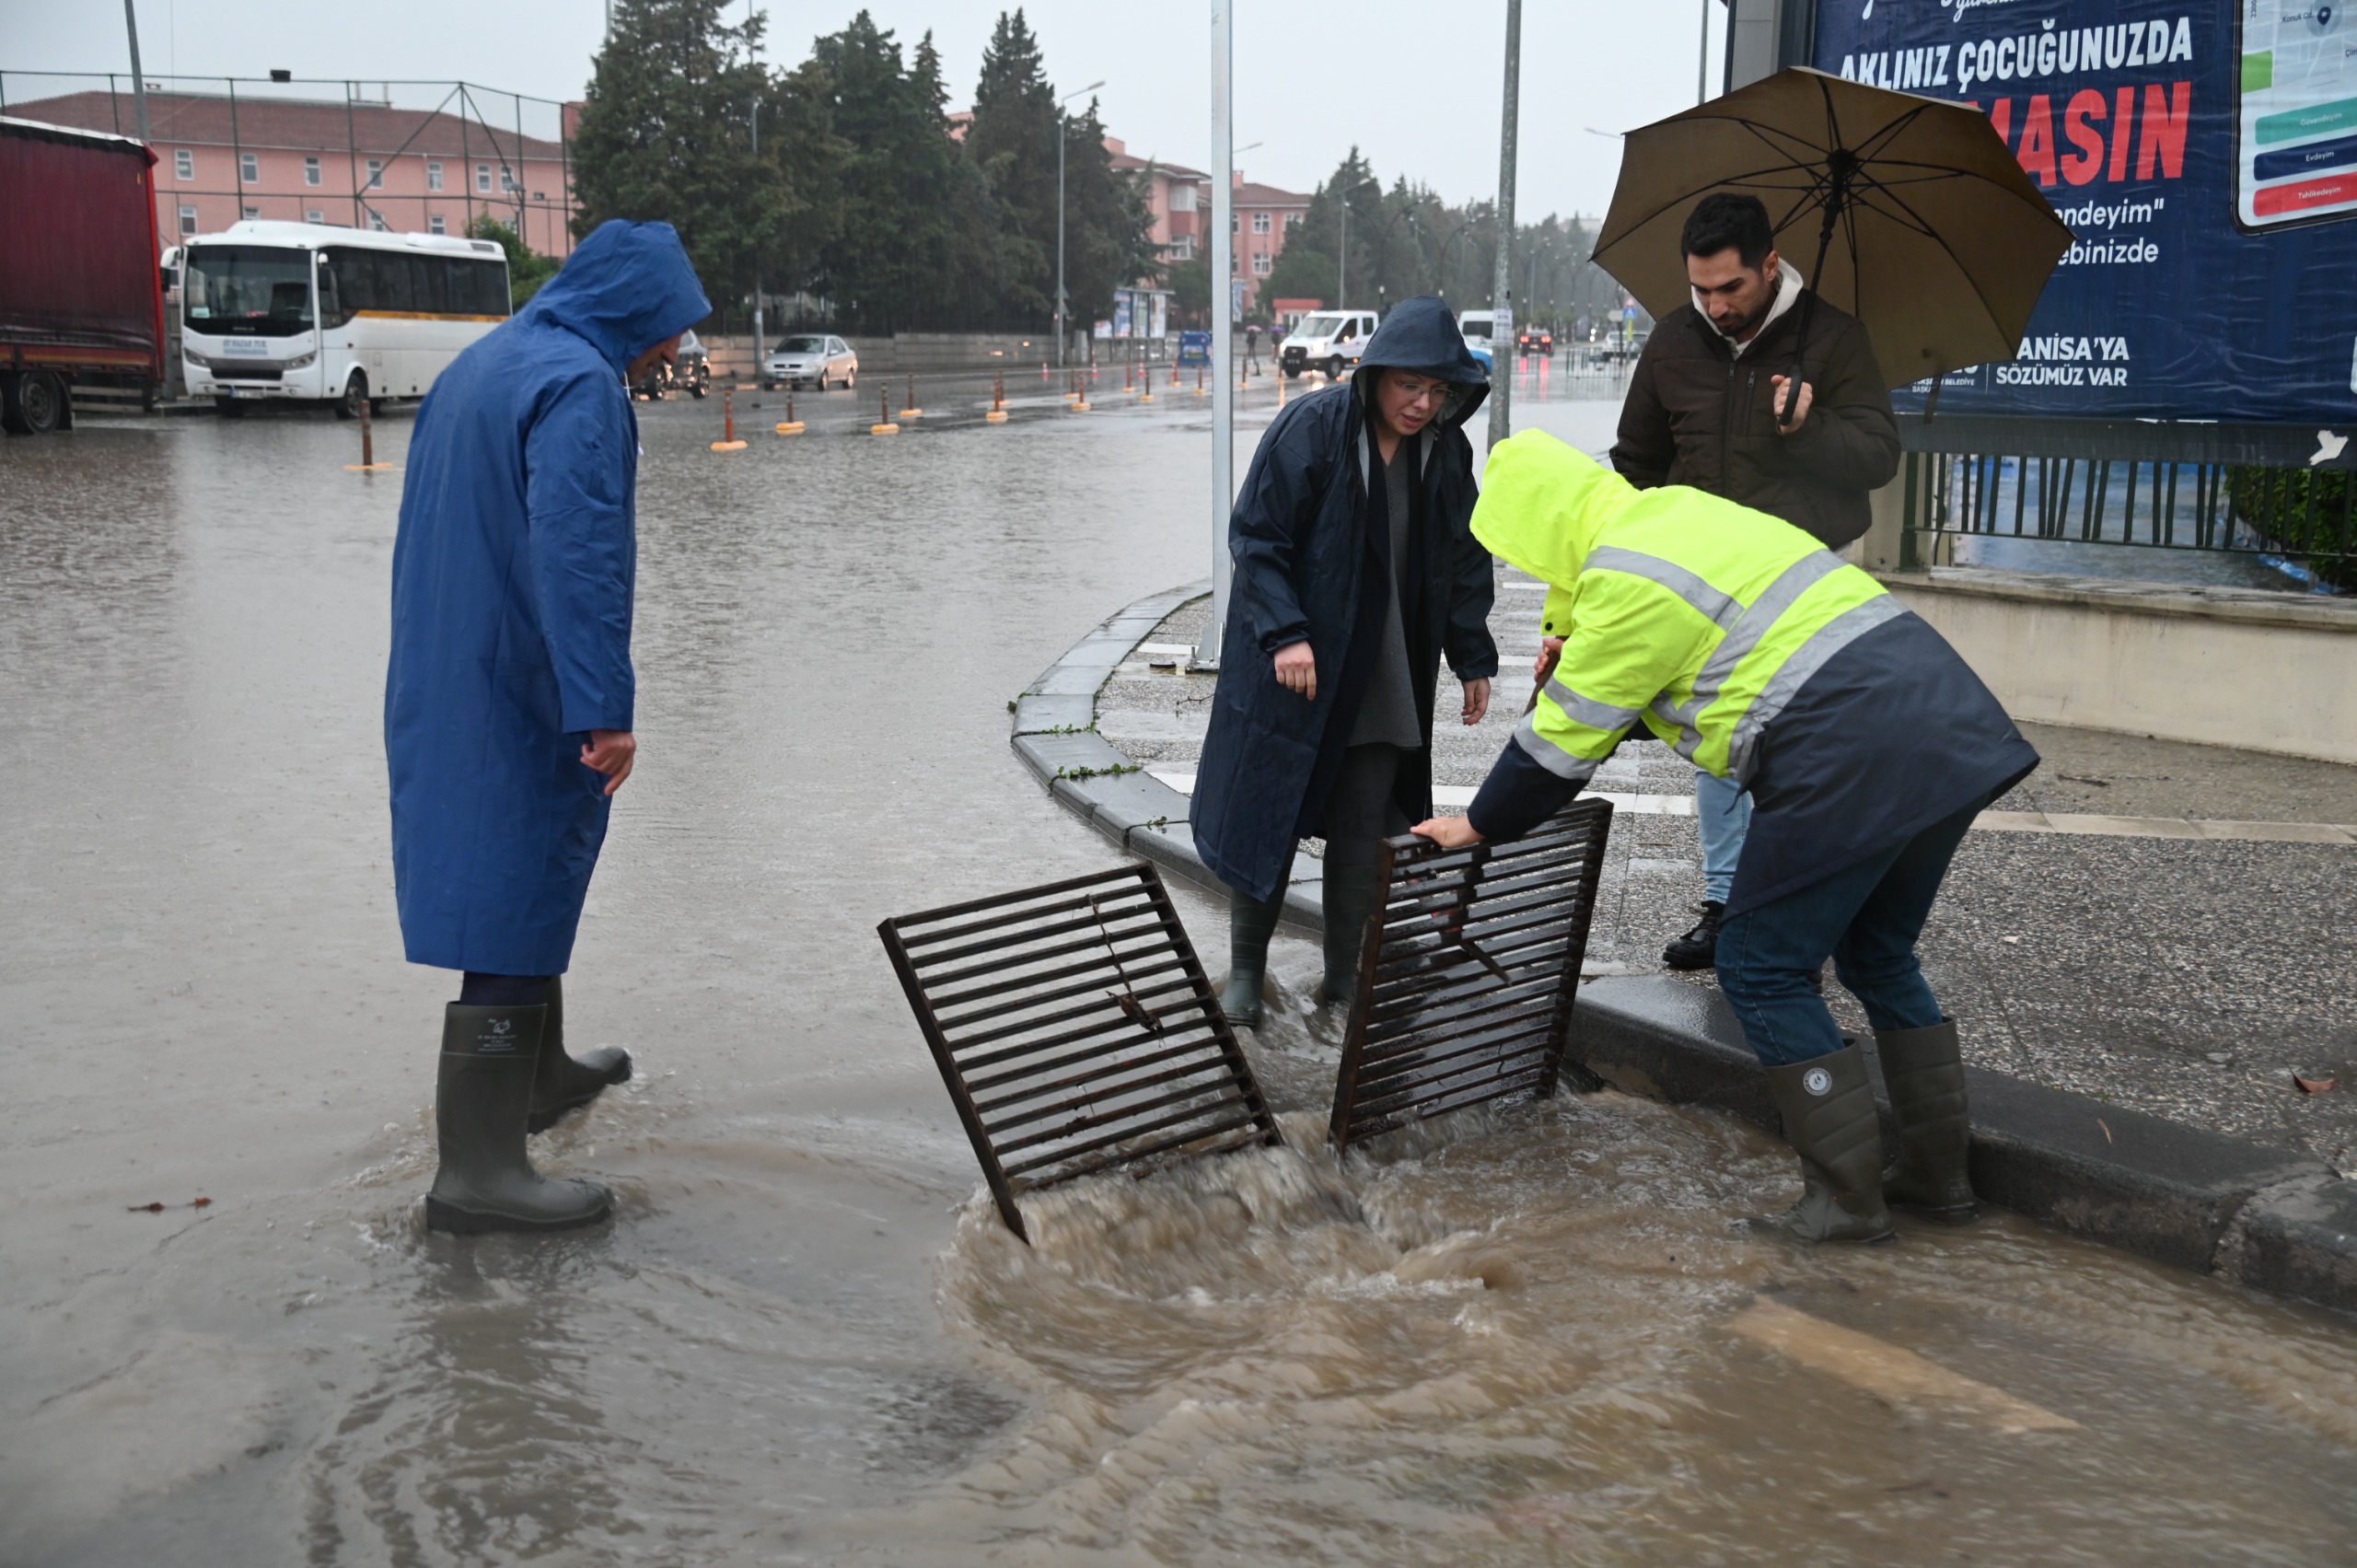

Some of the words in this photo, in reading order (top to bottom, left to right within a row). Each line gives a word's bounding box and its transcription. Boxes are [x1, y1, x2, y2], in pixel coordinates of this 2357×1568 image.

[1840, 44, 1951, 90] AKLINIZ
[1957, 17, 2192, 94] ÇOCUĞUNUZDA
[2300, 112, 2343, 126] Güvendeyim
[2305, 151, 2335, 162] Evdeyim
[2298, 186, 2341, 200] Tehlikedeyim
[2015, 332, 2131, 361] ANİSA'YA
[1945, 377, 1976, 387] BELEDİYE
[1996, 363, 2084, 386] SÖZÜMÜZ
[2087, 367, 2128, 387] VAR
